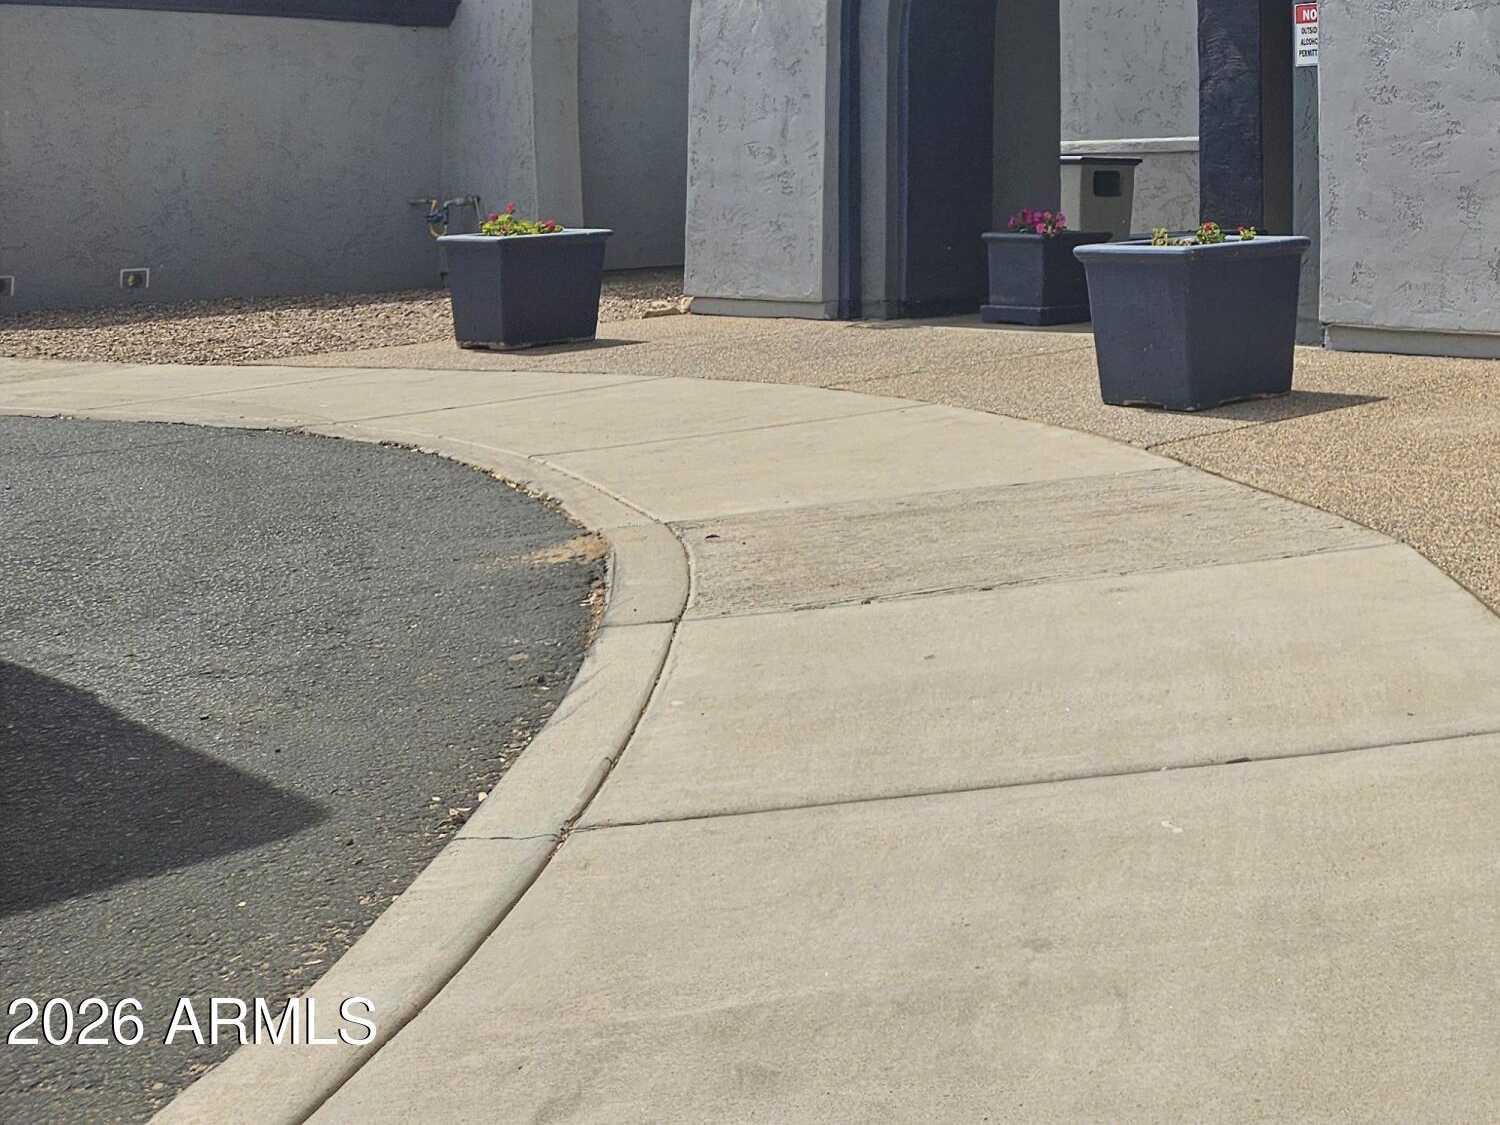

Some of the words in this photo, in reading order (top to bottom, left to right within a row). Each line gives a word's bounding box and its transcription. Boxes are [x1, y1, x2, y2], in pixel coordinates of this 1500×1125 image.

[1302, 8, 1317, 21] NO
[1301, 26, 1318, 35] OUTSID
[1298, 48, 1318, 57] PERMITT
